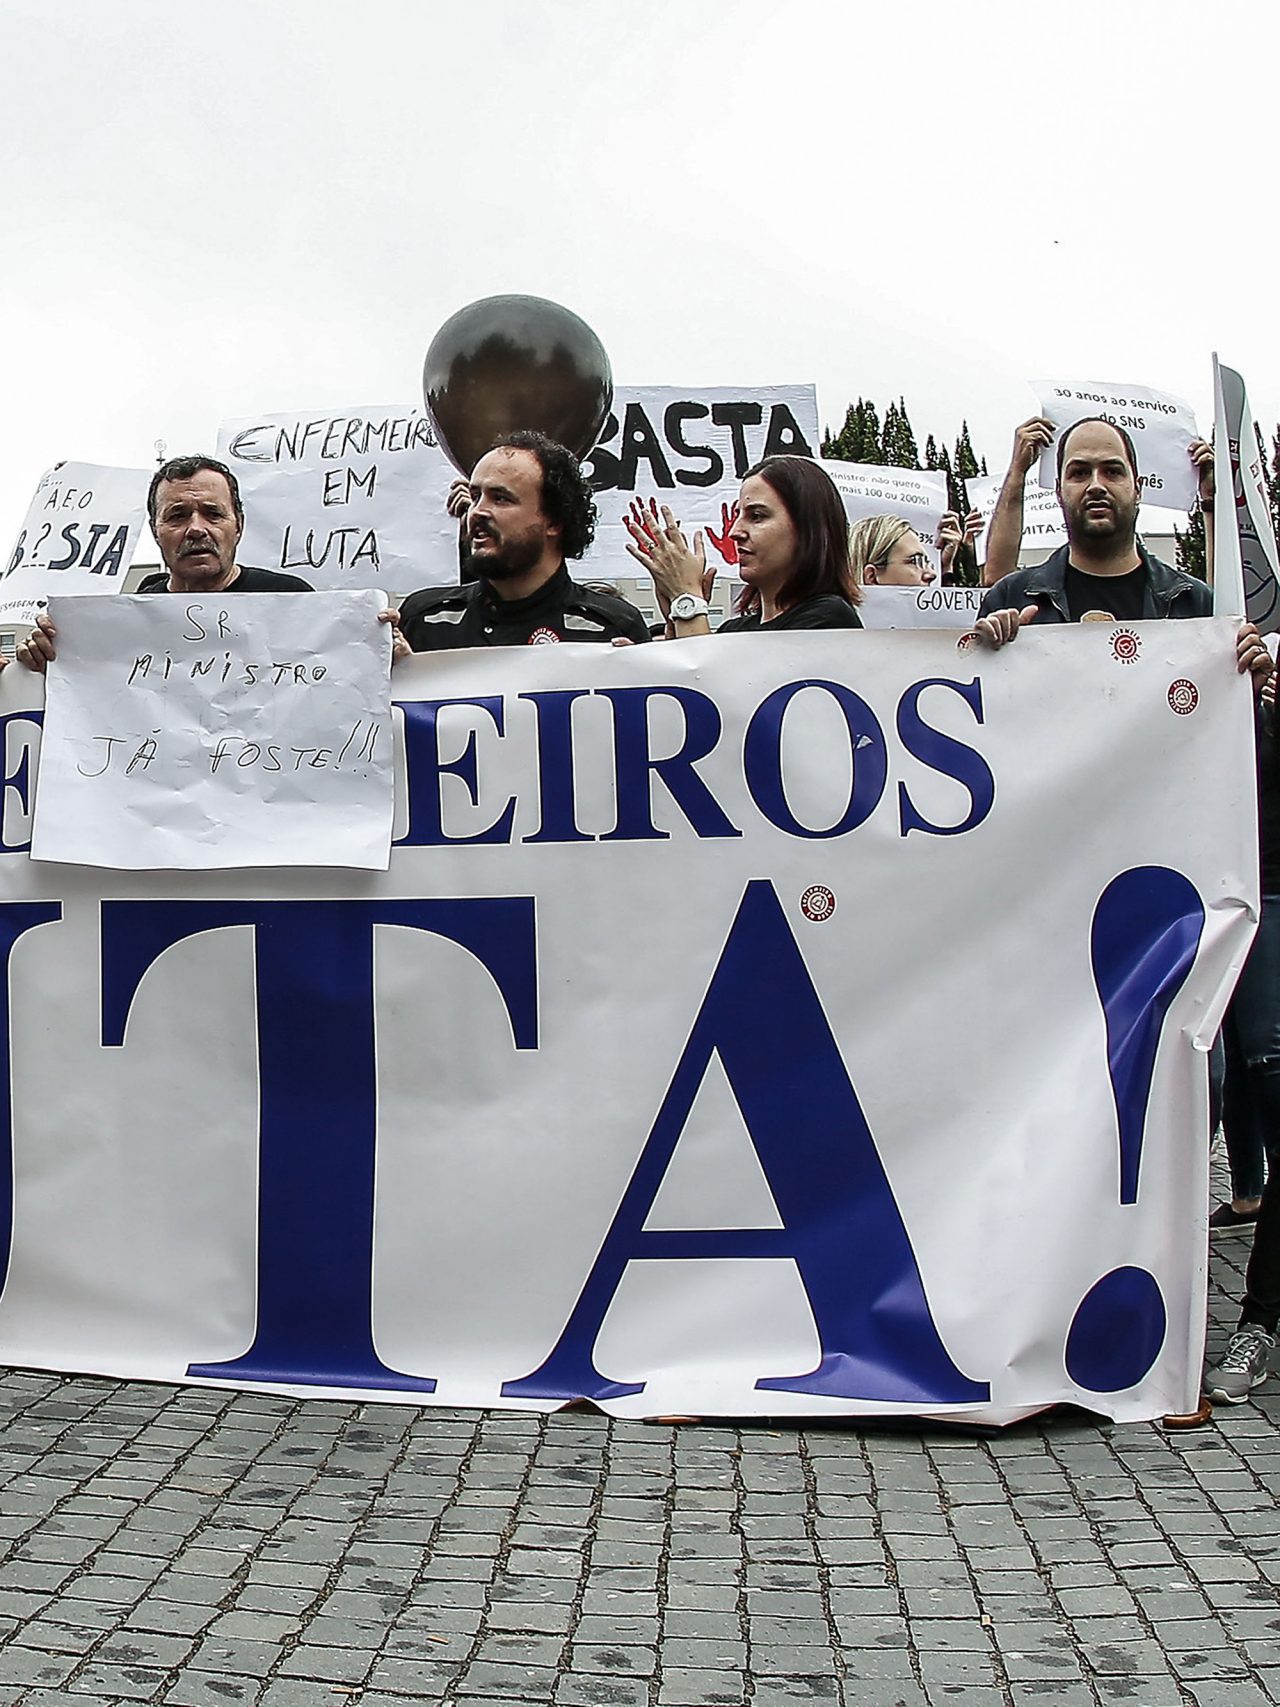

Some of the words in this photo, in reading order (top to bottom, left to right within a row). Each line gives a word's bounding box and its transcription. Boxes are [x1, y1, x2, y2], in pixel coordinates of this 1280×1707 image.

[1054, 388, 1072, 398] 30
[1075, 391, 1107, 404] anos
[1111, 397, 1127, 406] ao
[1131, 399, 1177, 415] serviço
[1120, 415, 1146, 430] SNS
[323, 464, 377, 507] EM
[865, 487, 882, 498] 100
[281, 523, 382, 572] LUTA
